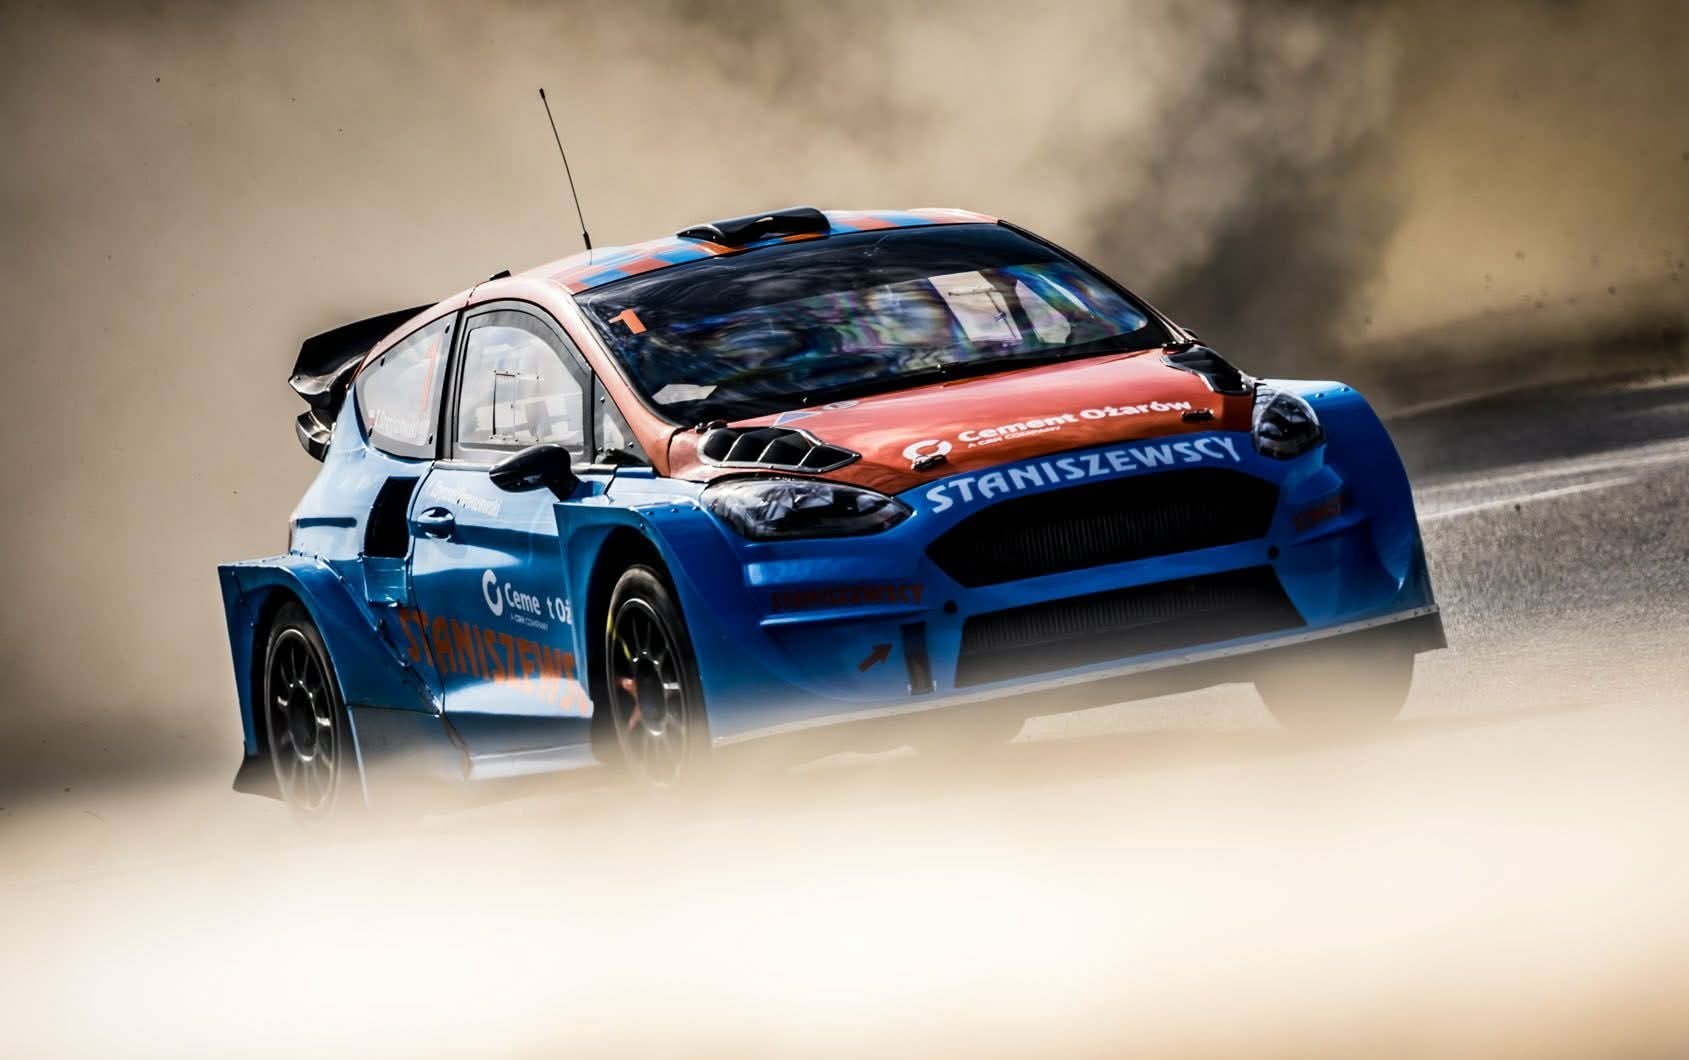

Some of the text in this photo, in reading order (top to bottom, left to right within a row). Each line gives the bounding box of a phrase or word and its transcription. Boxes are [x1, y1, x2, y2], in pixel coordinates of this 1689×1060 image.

[608, 309, 647, 335] 1
[957, 400, 1192, 442] Cement Ożarów
[926, 436, 1242, 514] STANISZEWSCY
